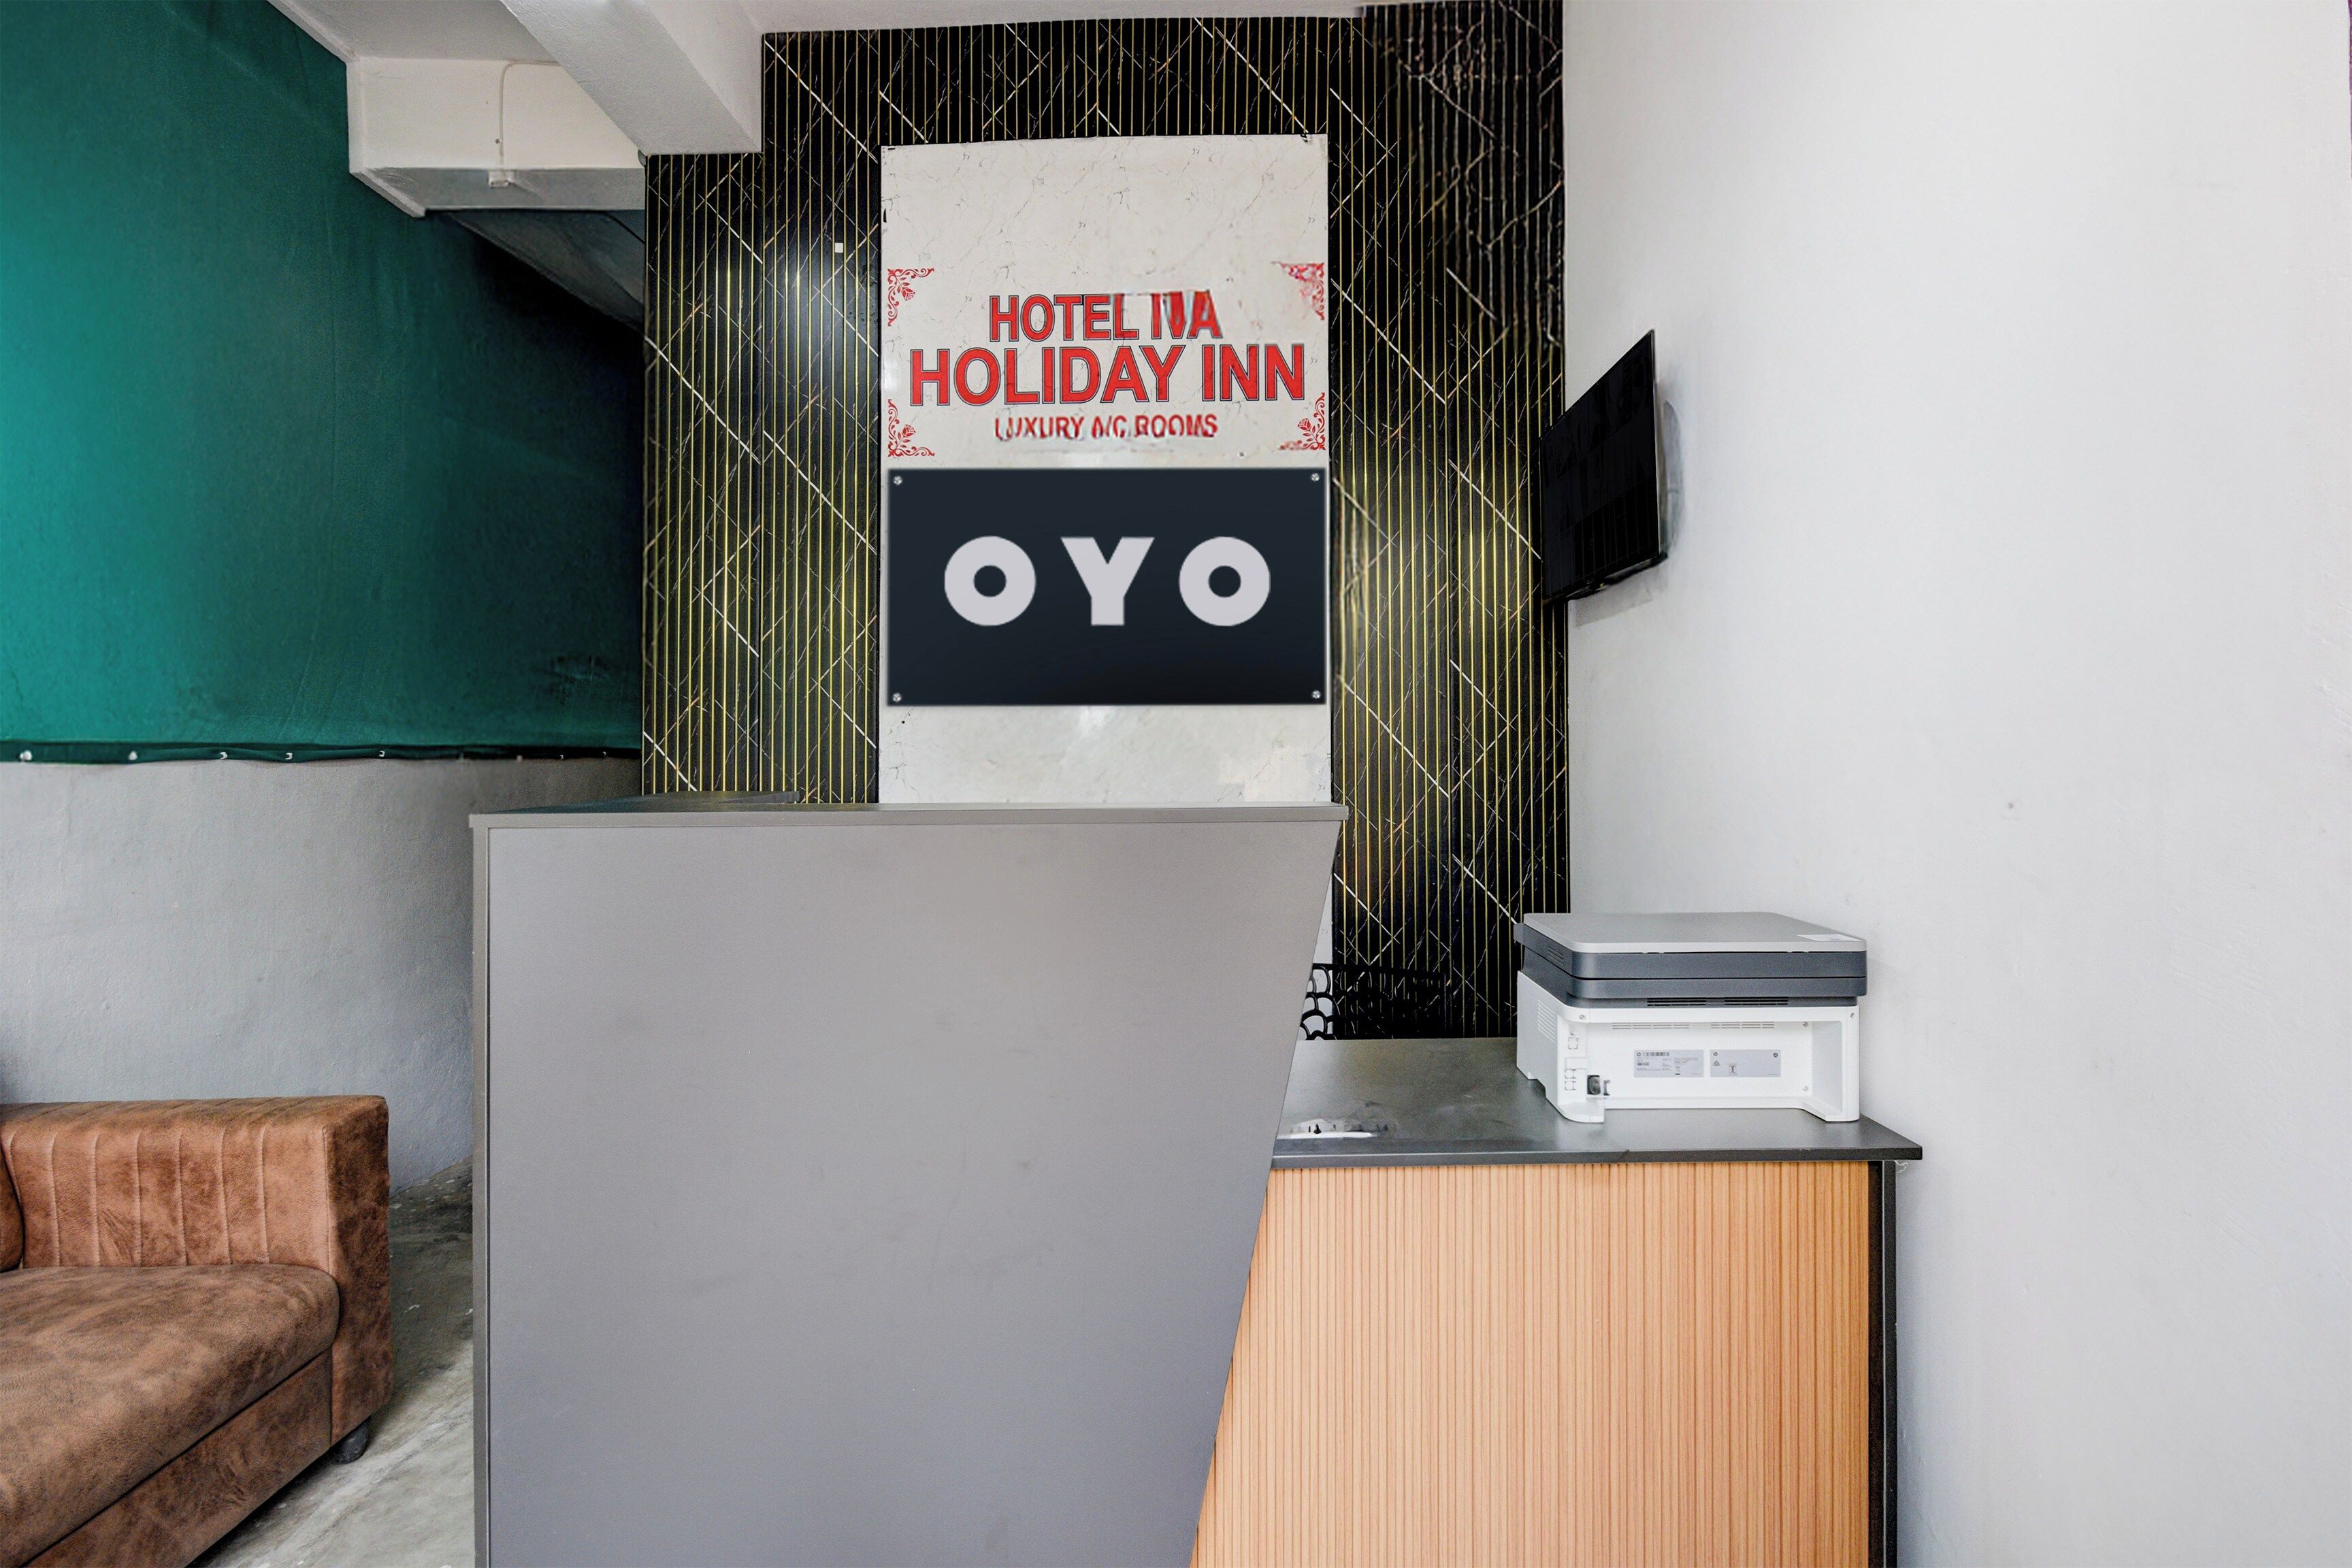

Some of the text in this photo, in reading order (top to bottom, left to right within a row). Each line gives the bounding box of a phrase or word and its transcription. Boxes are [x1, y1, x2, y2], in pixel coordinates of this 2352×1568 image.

[990, 294, 1139, 342] HOTEL
[909, 343, 1305, 406] HOLIDAY INN
[994, 415, 1085, 440] LUXURY
[1134, 413, 1218, 438] ROOMS
[944, 535, 1271, 627] OYO
